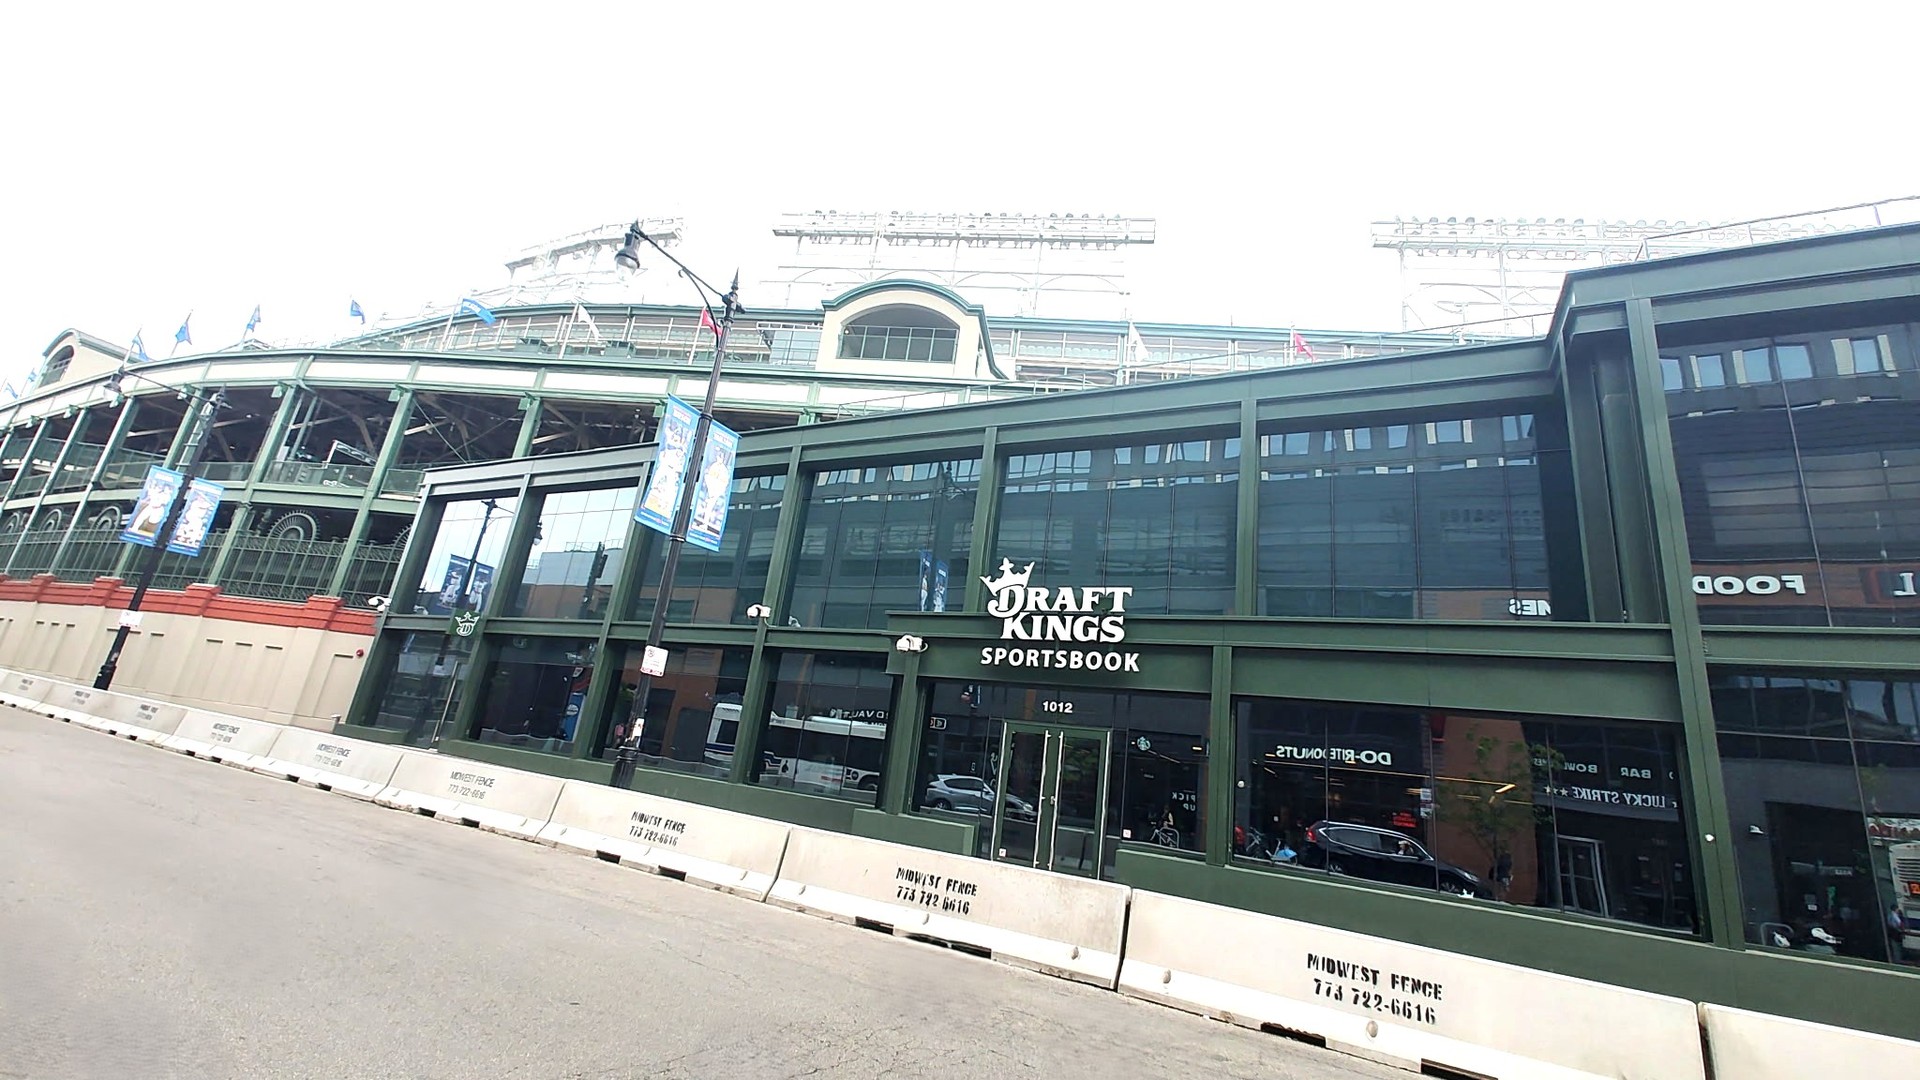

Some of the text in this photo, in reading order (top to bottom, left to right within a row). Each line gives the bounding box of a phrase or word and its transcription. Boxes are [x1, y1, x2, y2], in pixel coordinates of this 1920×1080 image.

[987, 585, 1133, 618] DRAFT
[1000, 612, 1125, 643] KINGS
[981, 647, 1140, 672] SPORTSBOOK
[1042, 701, 1073, 713] 1012
[450, 771, 495, 788] MIDWEST FENCE
[631, 811, 687, 834] MIDWEST FENCE
[896, 867, 978, 897] MIDWEST FENCE
[896, 885, 915, 901] 773
[1307, 953, 1443, 1001] MIDWEST FENCE
[1314, 978, 1436, 1025] 773 722-6616
